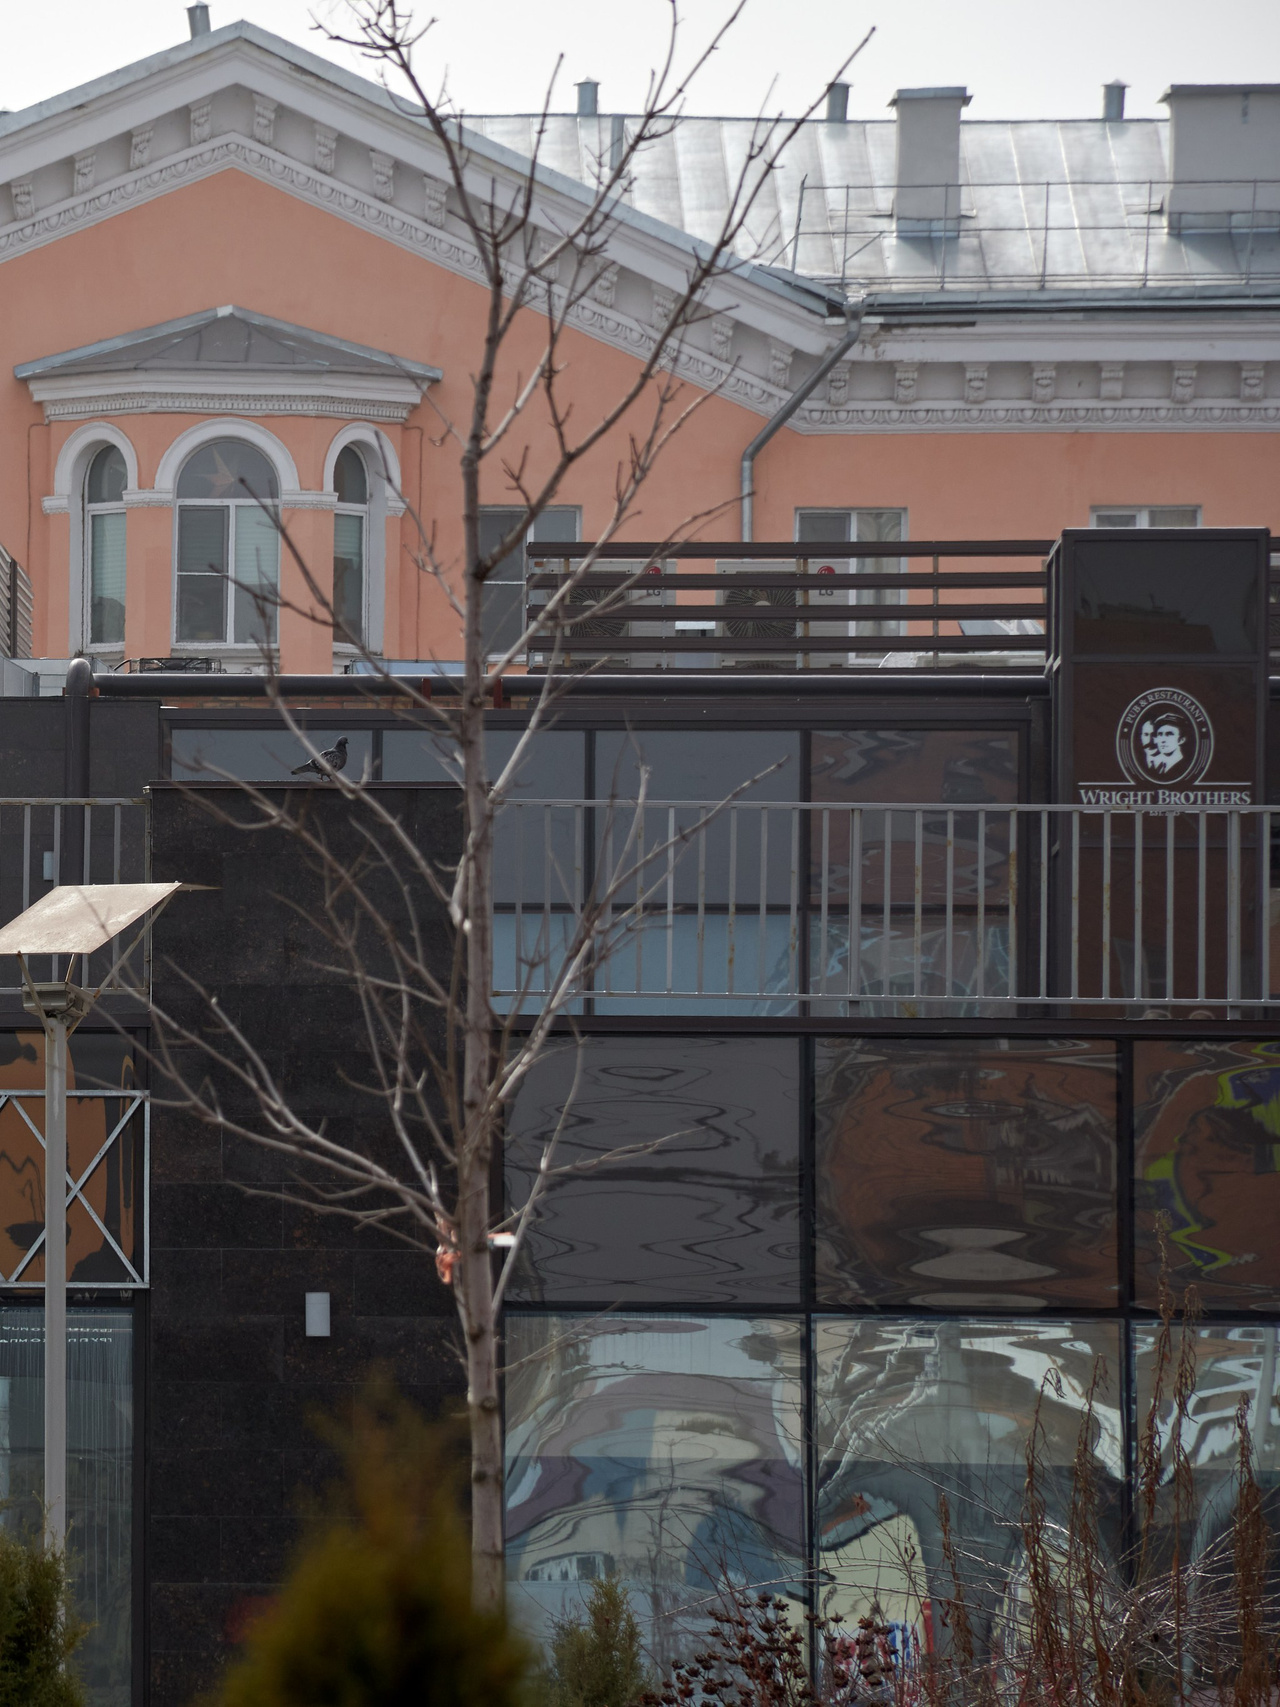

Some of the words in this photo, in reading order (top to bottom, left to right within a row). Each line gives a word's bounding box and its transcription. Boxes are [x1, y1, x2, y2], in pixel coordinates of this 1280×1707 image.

[818, 588, 834, 597] LG
[1125, 705, 1141, 724] PUB
[1138, 699, 1148, 707] &
[1147, 691, 1205, 722] RESTAURANT
[1079, 789, 1154, 805] WRIGHT
[1157, 789, 1252, 805] BROTHERS
